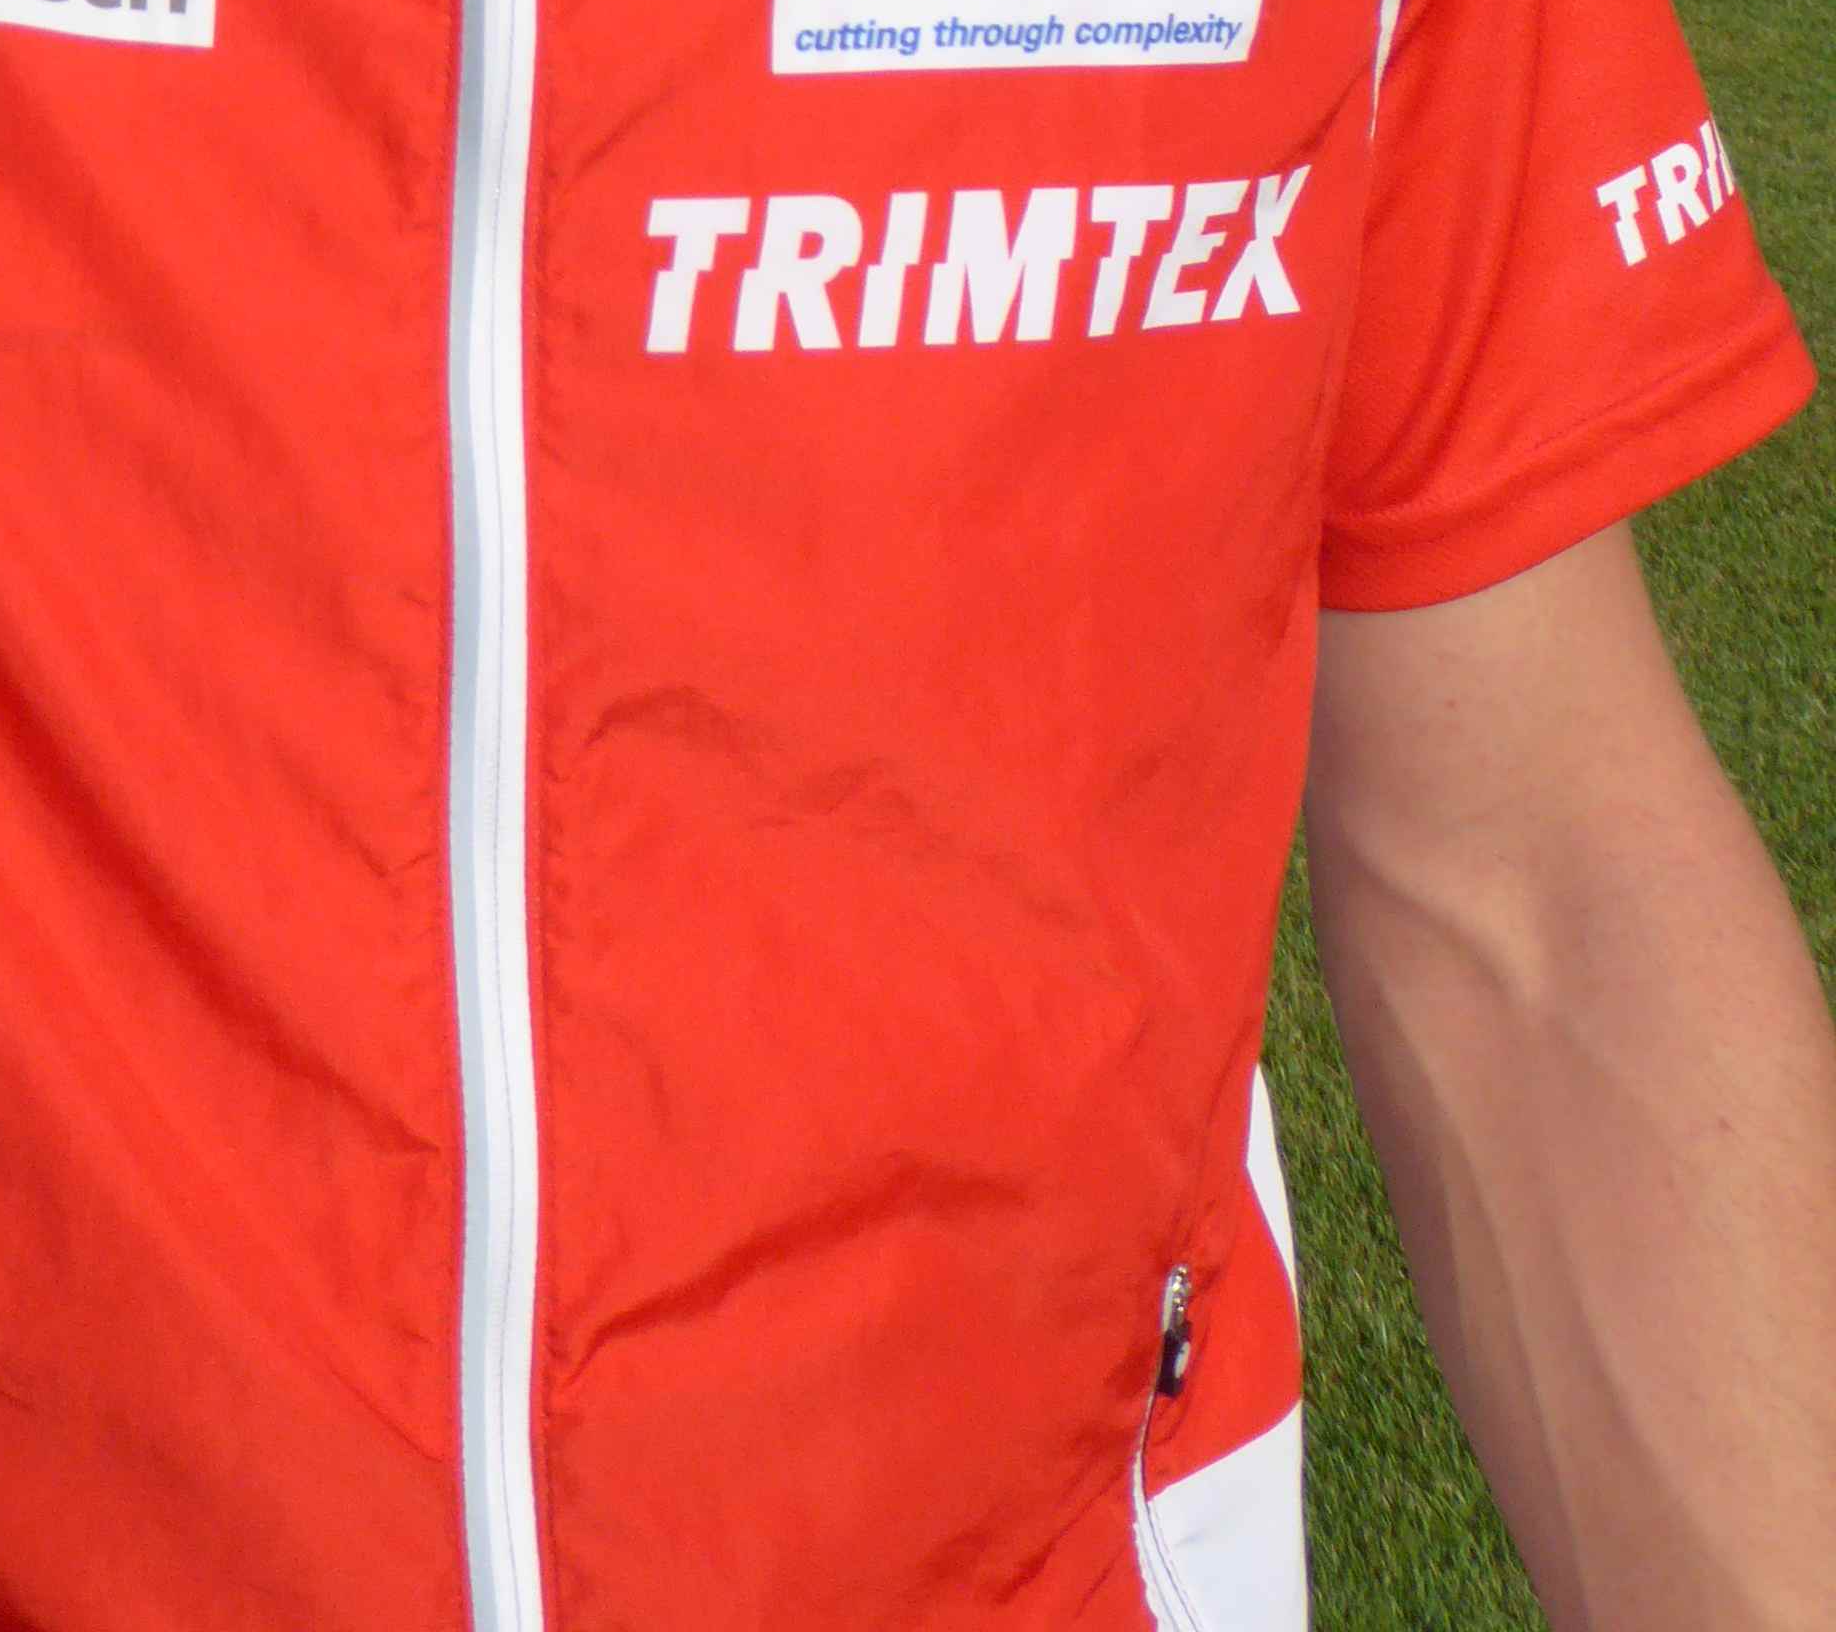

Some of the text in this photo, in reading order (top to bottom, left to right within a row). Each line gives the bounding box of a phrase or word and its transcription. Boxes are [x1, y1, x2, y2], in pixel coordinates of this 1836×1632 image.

[795, 12, 1243, 55] cutting through complexity
[645, 164, 1312, 354] TRIMTEX
[1596, 116, 1735, 267] TRI
